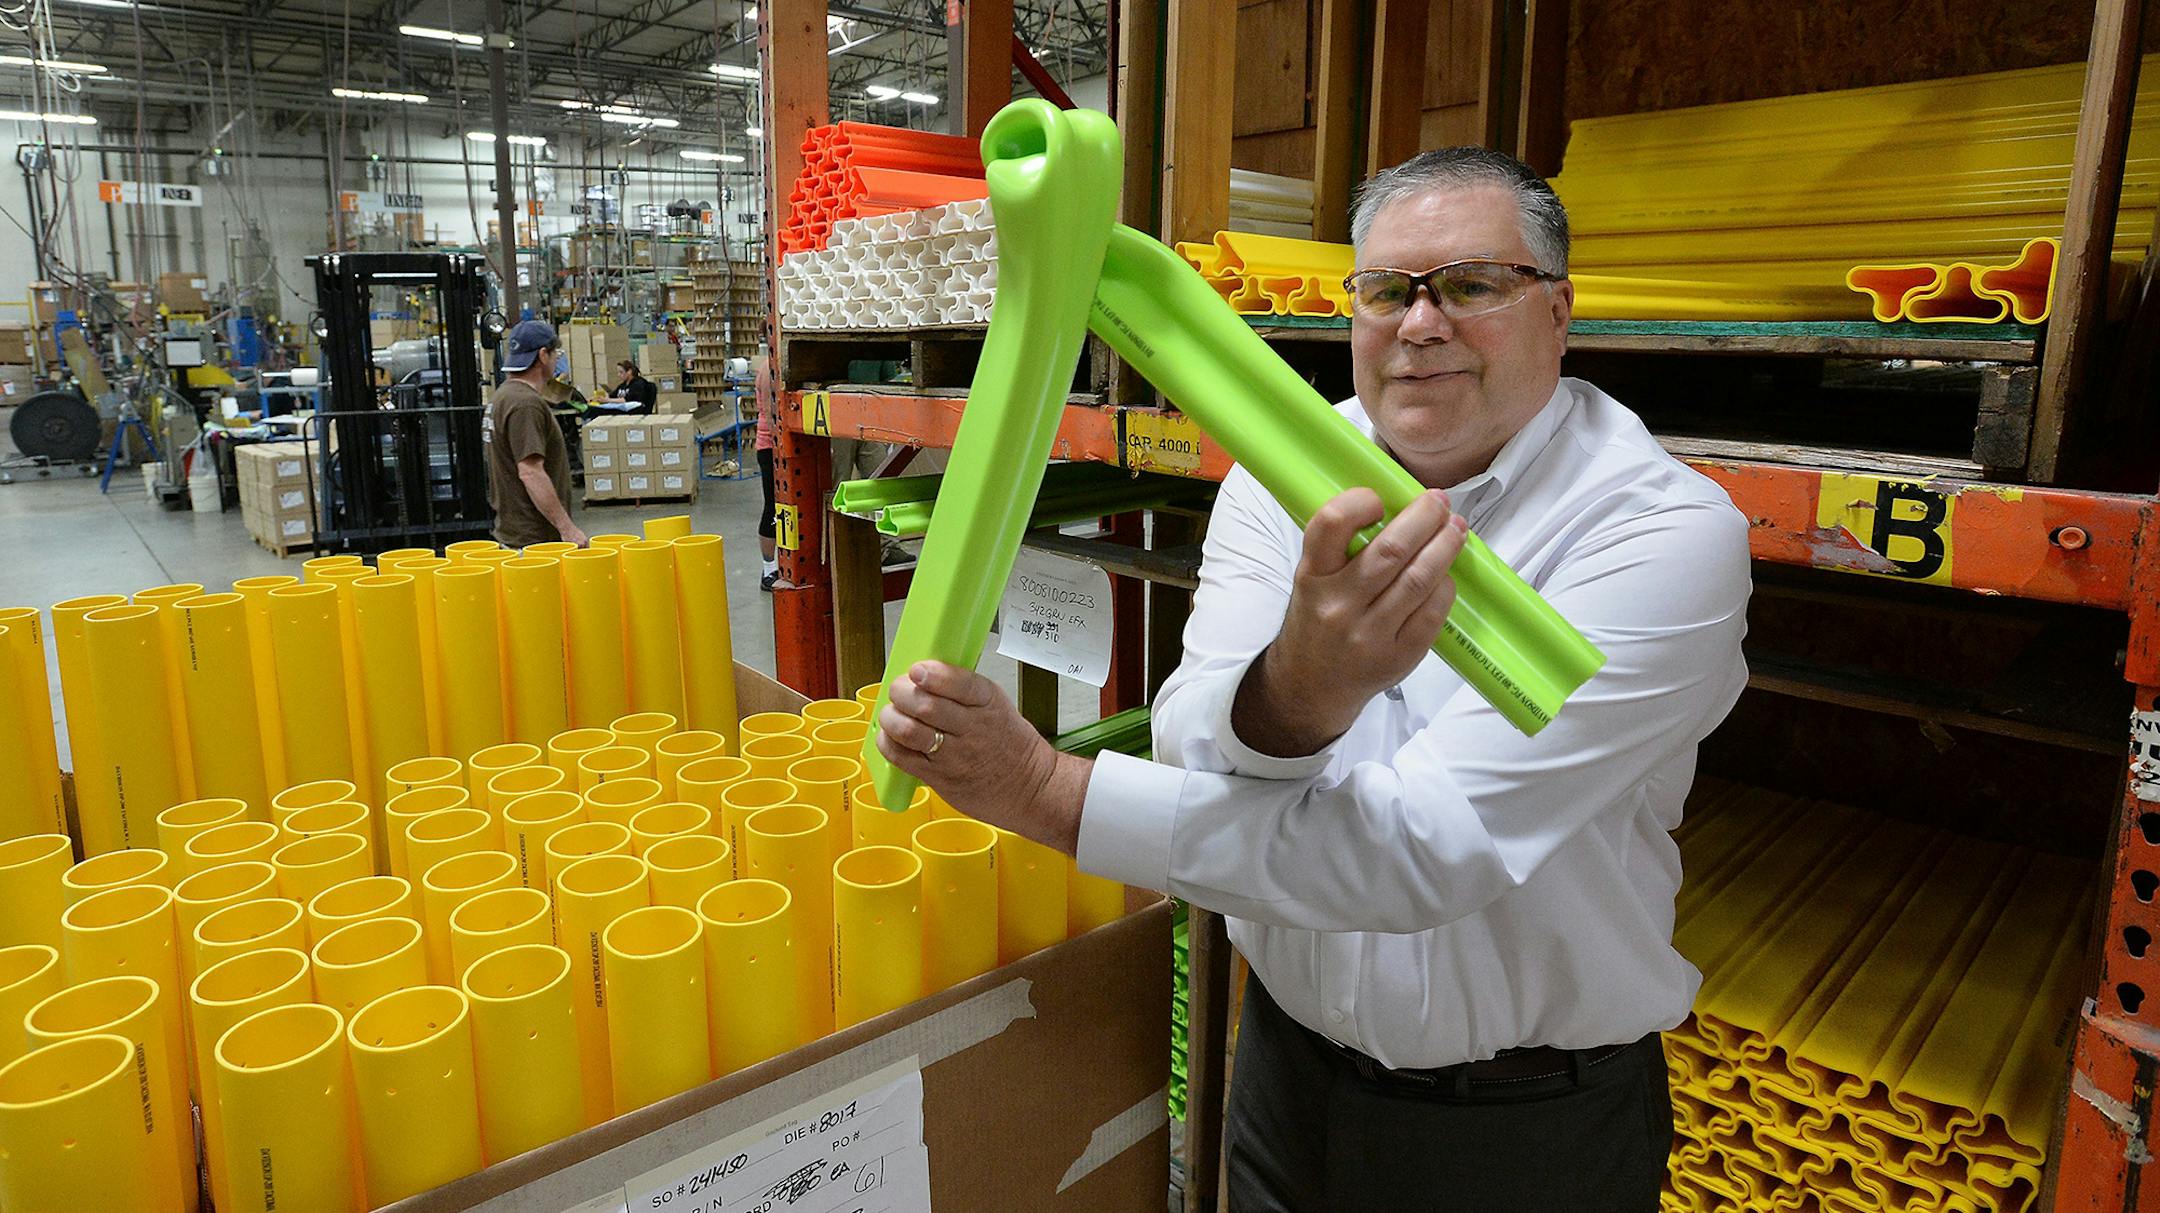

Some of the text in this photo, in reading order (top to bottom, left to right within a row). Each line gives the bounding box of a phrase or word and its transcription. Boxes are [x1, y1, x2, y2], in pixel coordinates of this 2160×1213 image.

[814, 394, 829, 435] A
[1159, 439, 1190, 453] 4000
[777, 508, 786, 546] 1
[1871, 481, 1946, 578] B
[1019, 576, 1095, 608] 8008100223
[652, 1191, 673, 1209] SO
[677, 1183, 685, 1197] #
[689, 1153, 748, 1195] 241450
[784, 1127, 806, 1145] DIE
[809, 1122, 817, 1134] #
[819, 1101, 857, 1133] 8017
[832, 1136, 850, 1151] PO
[853, 1130, 860, 1141] #
[746, 1201, 772, 1213] RD
[854, 1156, 884, 1193] 61
